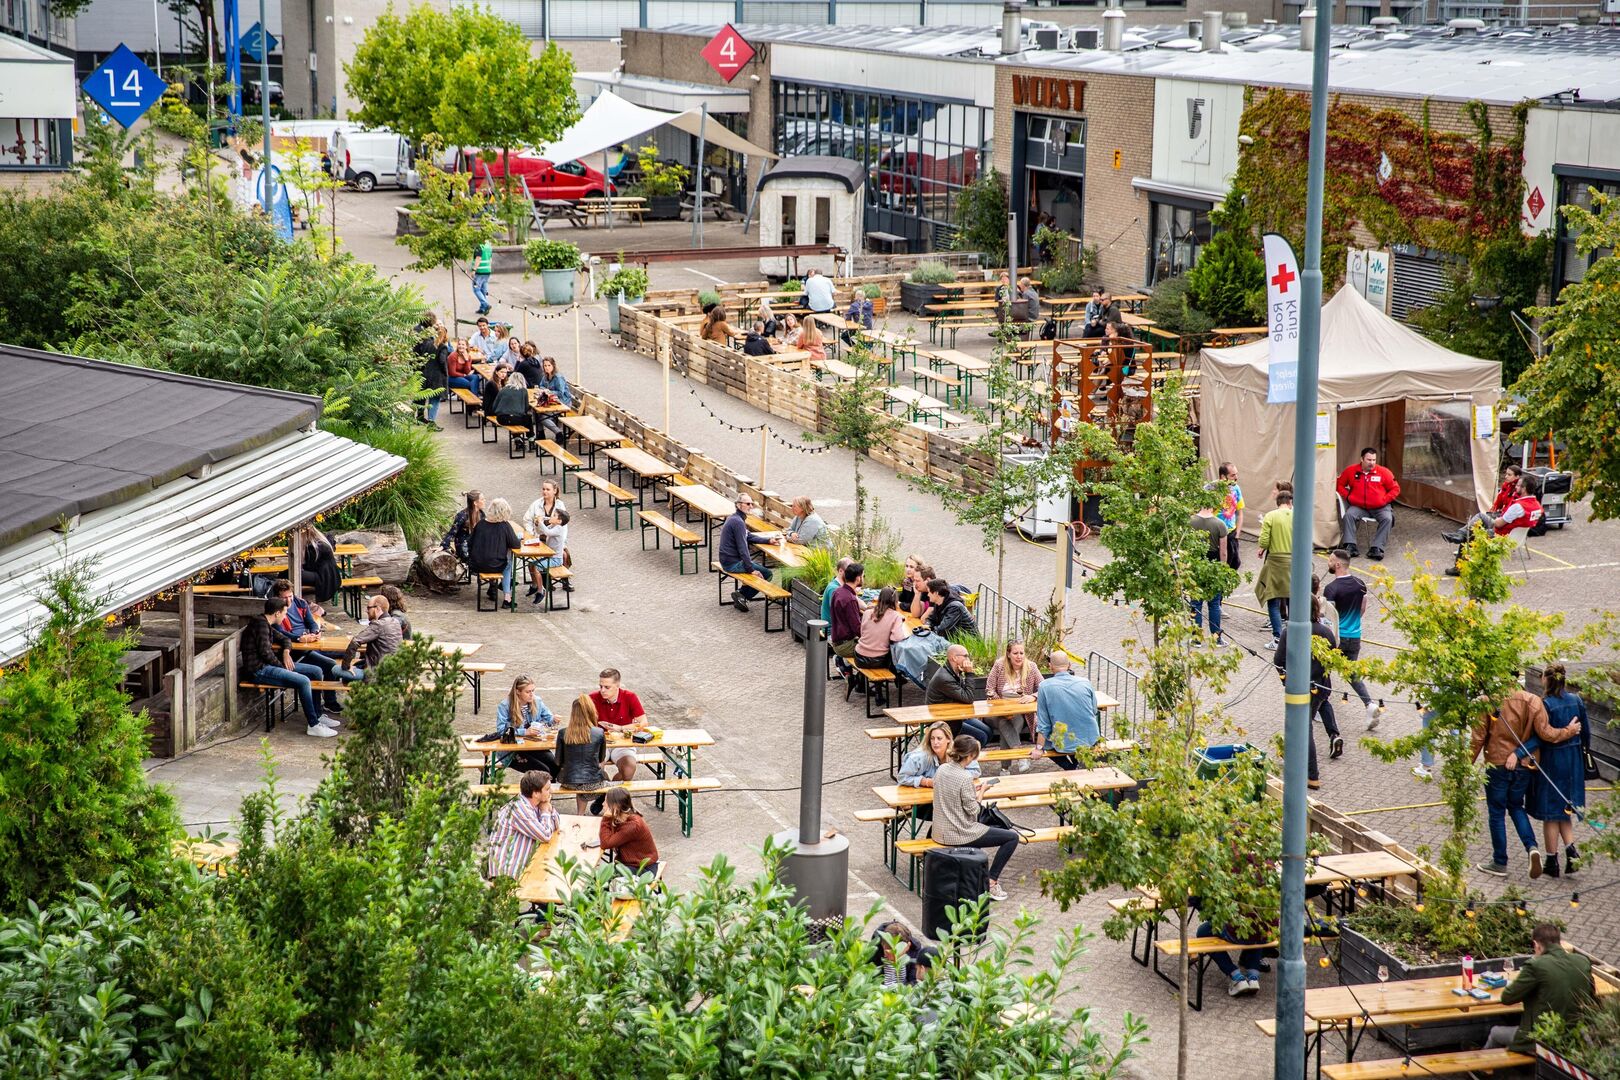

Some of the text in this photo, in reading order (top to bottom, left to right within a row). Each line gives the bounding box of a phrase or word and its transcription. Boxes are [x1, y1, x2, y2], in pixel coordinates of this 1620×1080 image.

[251, 31, 262, 48] 2
[720, 37, 737, 61] 4
[103, 69, 143, 97] 14
[1012, 74, 1087, 112] WORST
[1114, 151, 1121, 166] F
[1532, 190, 1539, 202] 4
